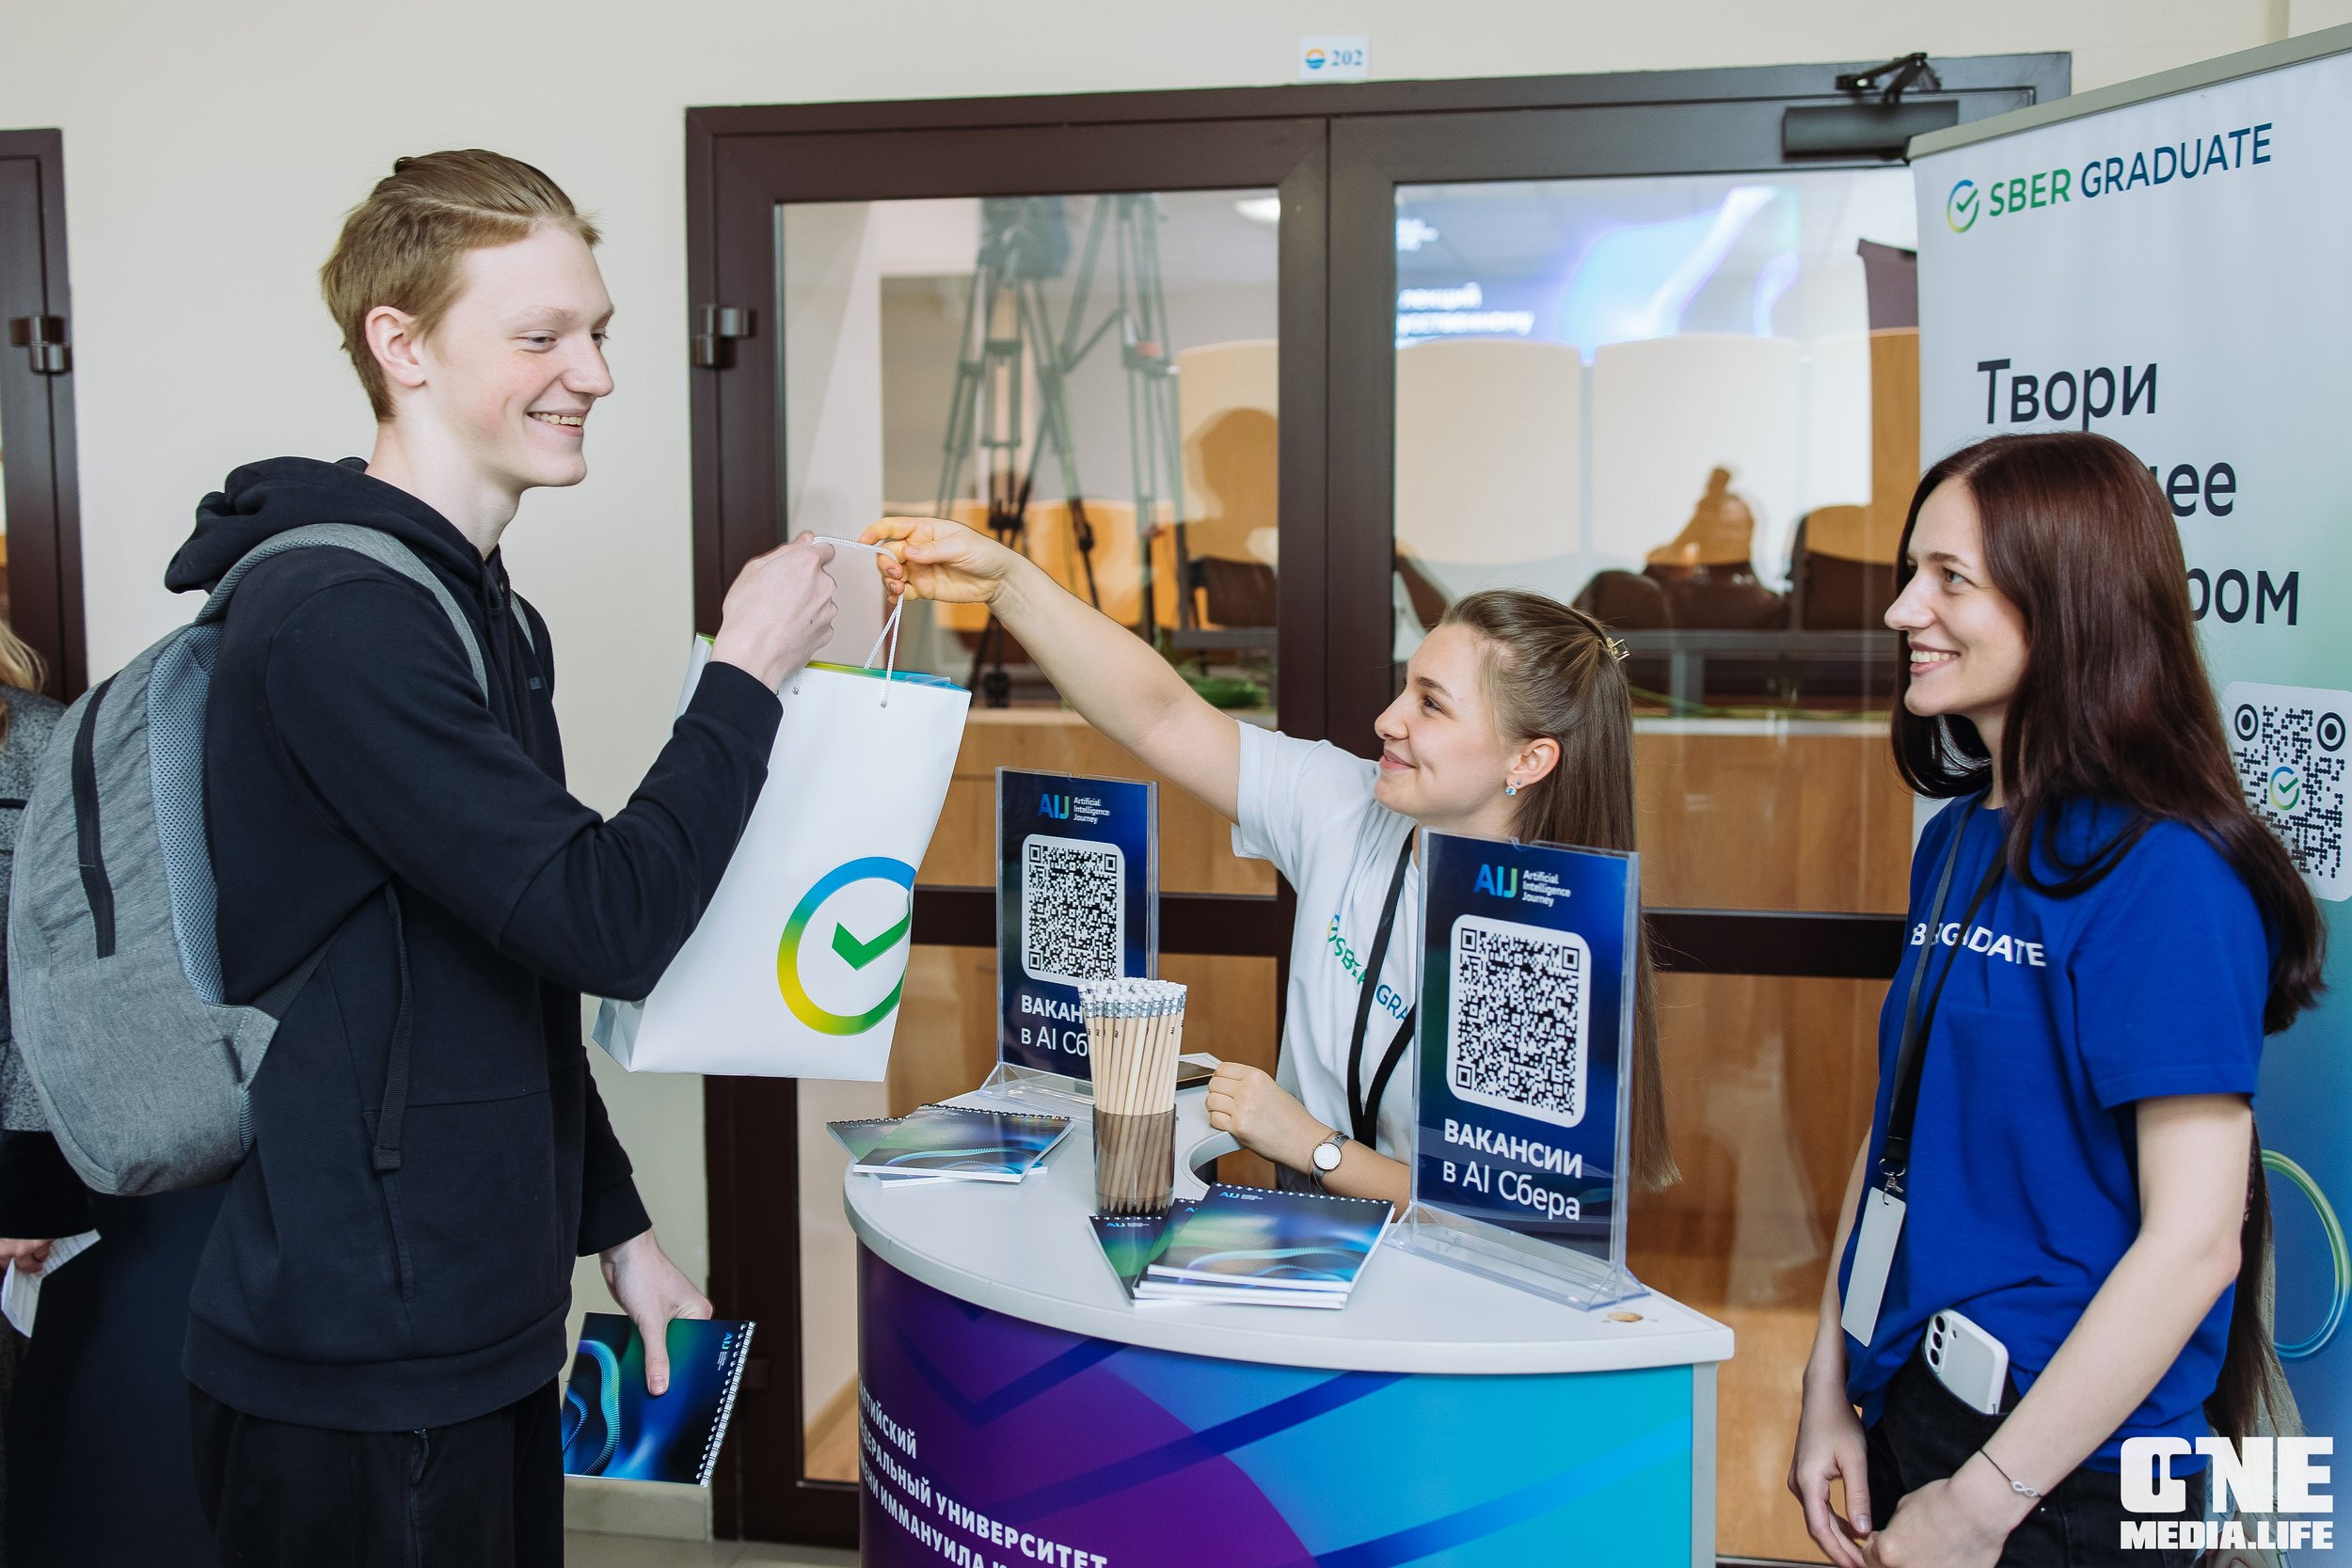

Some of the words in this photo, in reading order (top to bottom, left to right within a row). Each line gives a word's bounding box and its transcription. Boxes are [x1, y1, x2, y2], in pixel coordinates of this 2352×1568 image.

[1331, 49, 1363, 66] 202
[1989, 168, 2071, 217] SBER
[2081, 122, 2273, 198] GRADUATE
[1978, 358, 2158, 432] Твори
[2150, 462, 2236, 517] ее
[1038, 793, 1070, 819] AIJ
[1073, 797, 1102, 807] Artificial
[1073, 805, 1110, 816] Intelligence
[1073, 814, 1099, 825] Journey
[1473, 863, 1518, 898] AIJ
[1522, 869, 1559, 884] Artificial
[1522, 880, 1571, 898] Intelligence
[1521, 892, 1555, 908] Journey
[1021, 994, 1084, 1024] ВАКАН
[1021, 1027, 1032, 1045] в
[1036, 1025, 1057, 1051] AI
[1444, 1117, 1582, 1180] ВАКАНСИИ
[1442, 1161, 1456, 1184] в
[1462, 1160, 1490, 1194] AI
[1498, 1170, 1581, 1222] Сбера
[881, 1485, 985, 1568] ИММАНУИЛА
[935, 1492, 1108, 1568] УНИВЕРСИТЕТ
